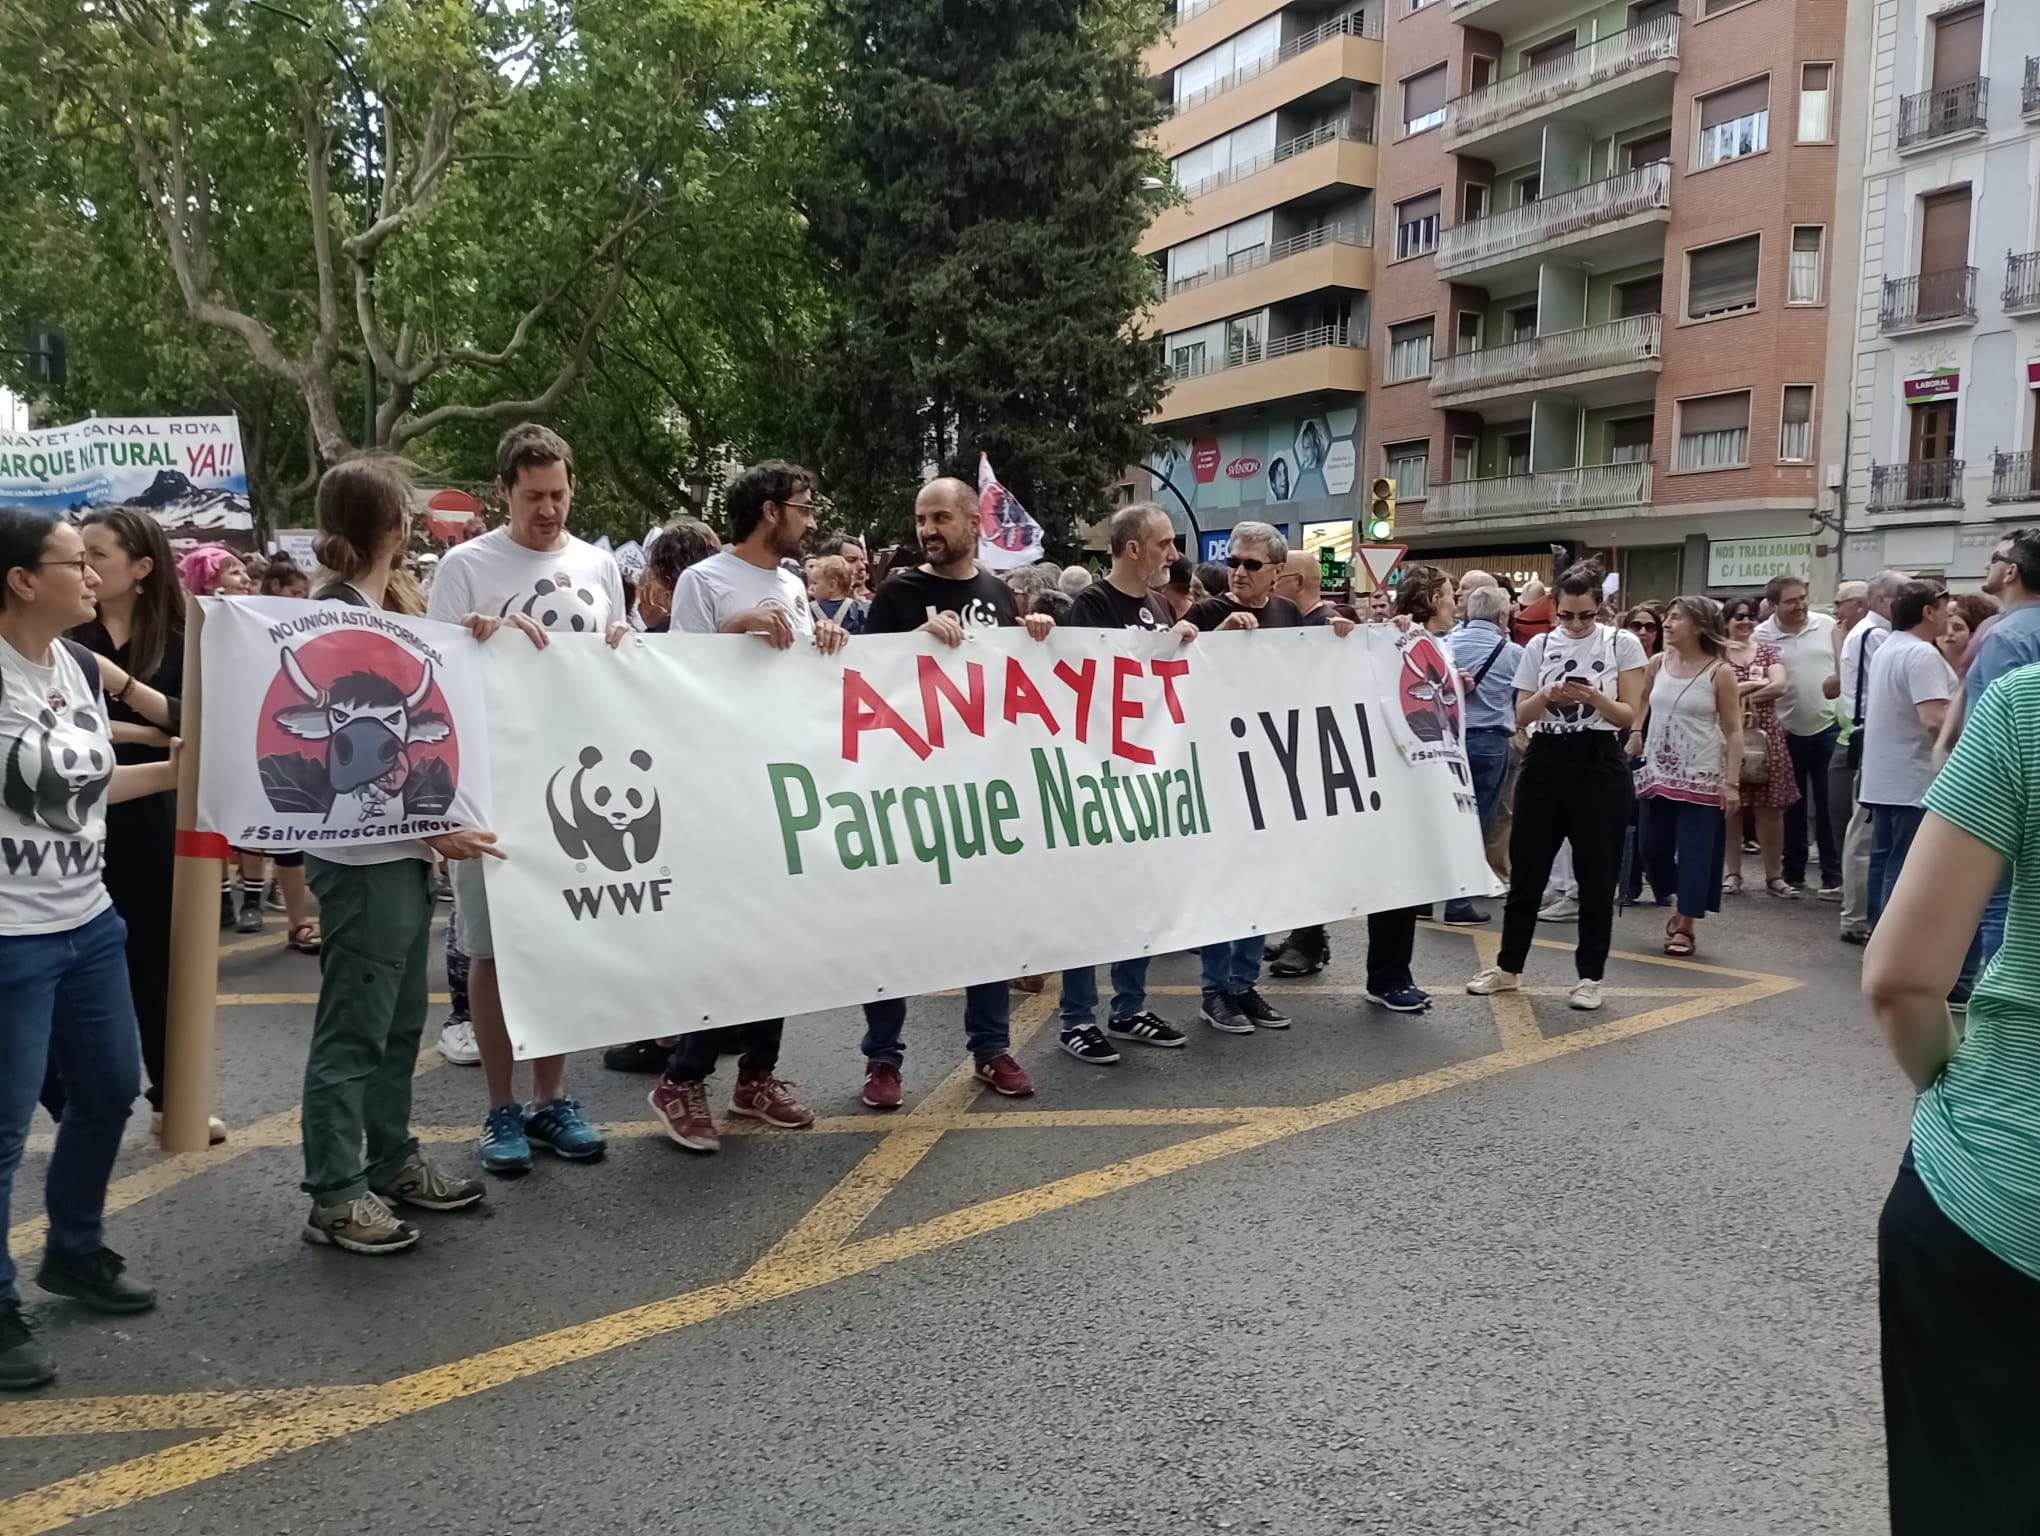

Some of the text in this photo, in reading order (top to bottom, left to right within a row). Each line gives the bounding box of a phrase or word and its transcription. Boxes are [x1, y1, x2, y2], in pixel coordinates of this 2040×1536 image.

[1915, 378, 1950, 390] LABORAL
[0, 431, 70, 448] NAYET
[83, 423, 160, 438] CANAL
[169, 423, 222, 435] ROYA
[79, 442, 178, 471] NATURAL
[186, 443, 233, 478] YA!!
[1715, 545, 1735, 559] NOS
[1721, 564, 1735, 577] C/
[268, 623, 294, 644] NO
[294, 609, 340, 633] UNIÓN
[840, 654, 1190, 765] ANAYET
[767, 703, 1381, 885] Parque Natural ¡YA!
[562, 878, 673, 921] WWF
